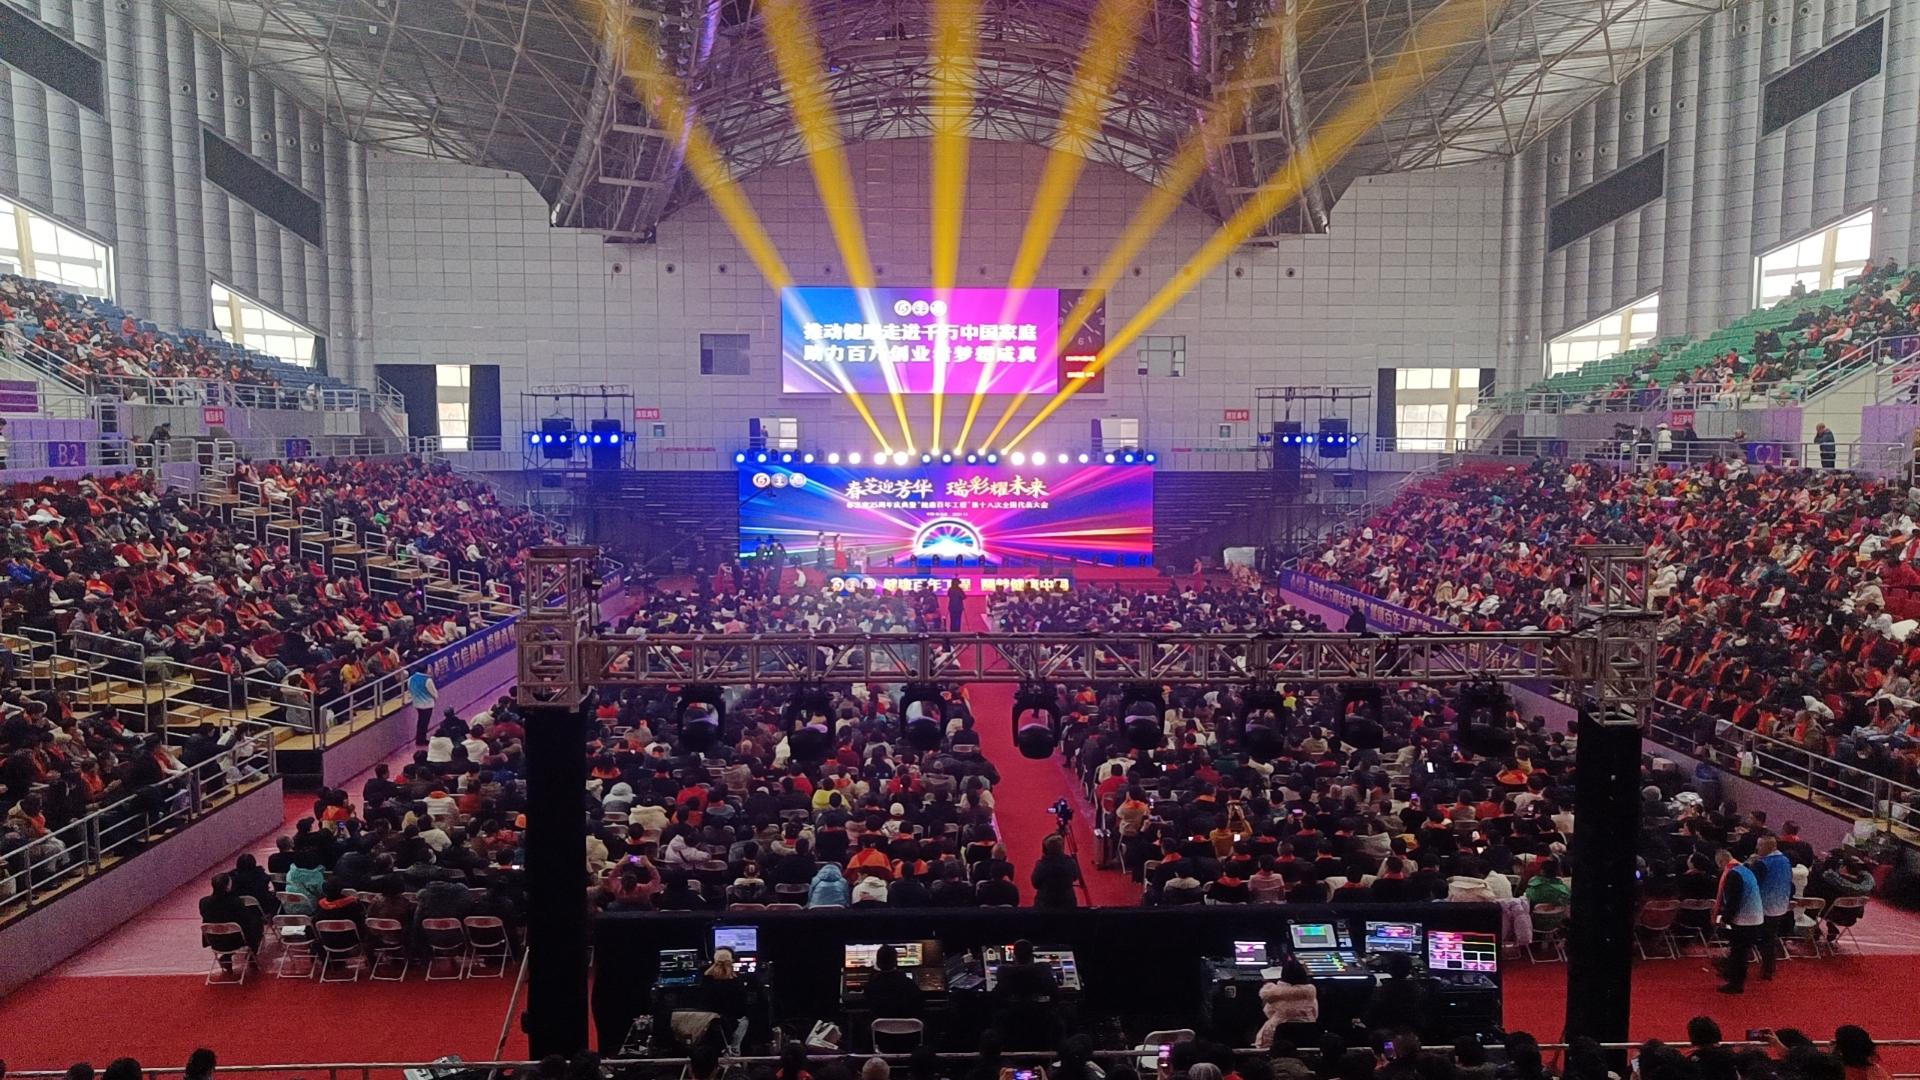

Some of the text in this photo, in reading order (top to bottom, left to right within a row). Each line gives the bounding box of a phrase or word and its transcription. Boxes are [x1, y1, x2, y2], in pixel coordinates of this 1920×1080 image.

[1077, 337, 1084, 345] 6
[58, 443, 79, 466] B2
[1755, 444, 1774, 464] C2
[845, 475, 1049, 499] 春芝迎芳华 瑞彩耀未来
